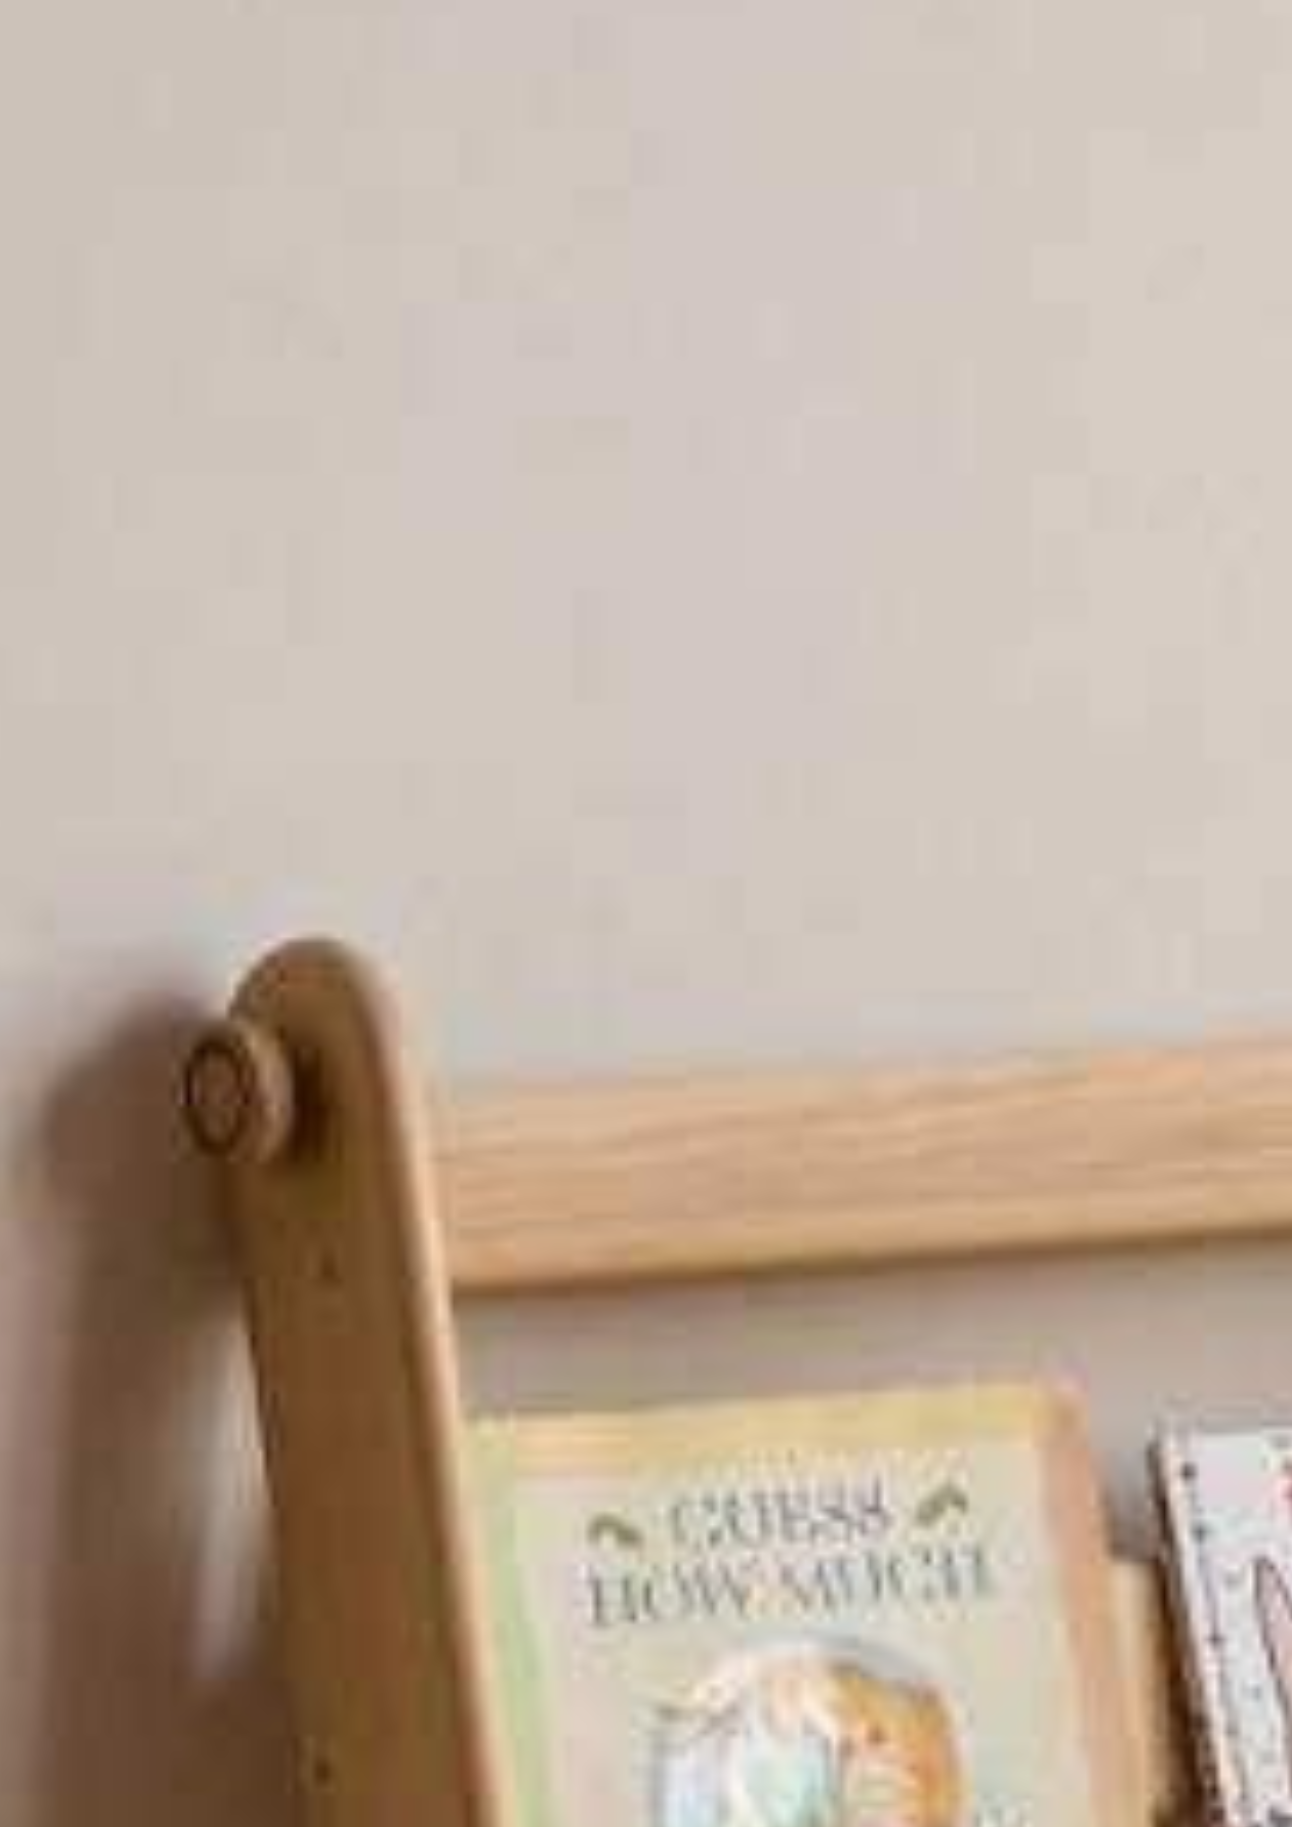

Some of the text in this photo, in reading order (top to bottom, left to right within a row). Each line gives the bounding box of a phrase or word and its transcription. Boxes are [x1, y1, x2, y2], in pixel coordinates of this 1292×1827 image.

[669, 1478, 892, 1548] GUESS
[586, 1543, 1000, 1630] HOW MUCH
